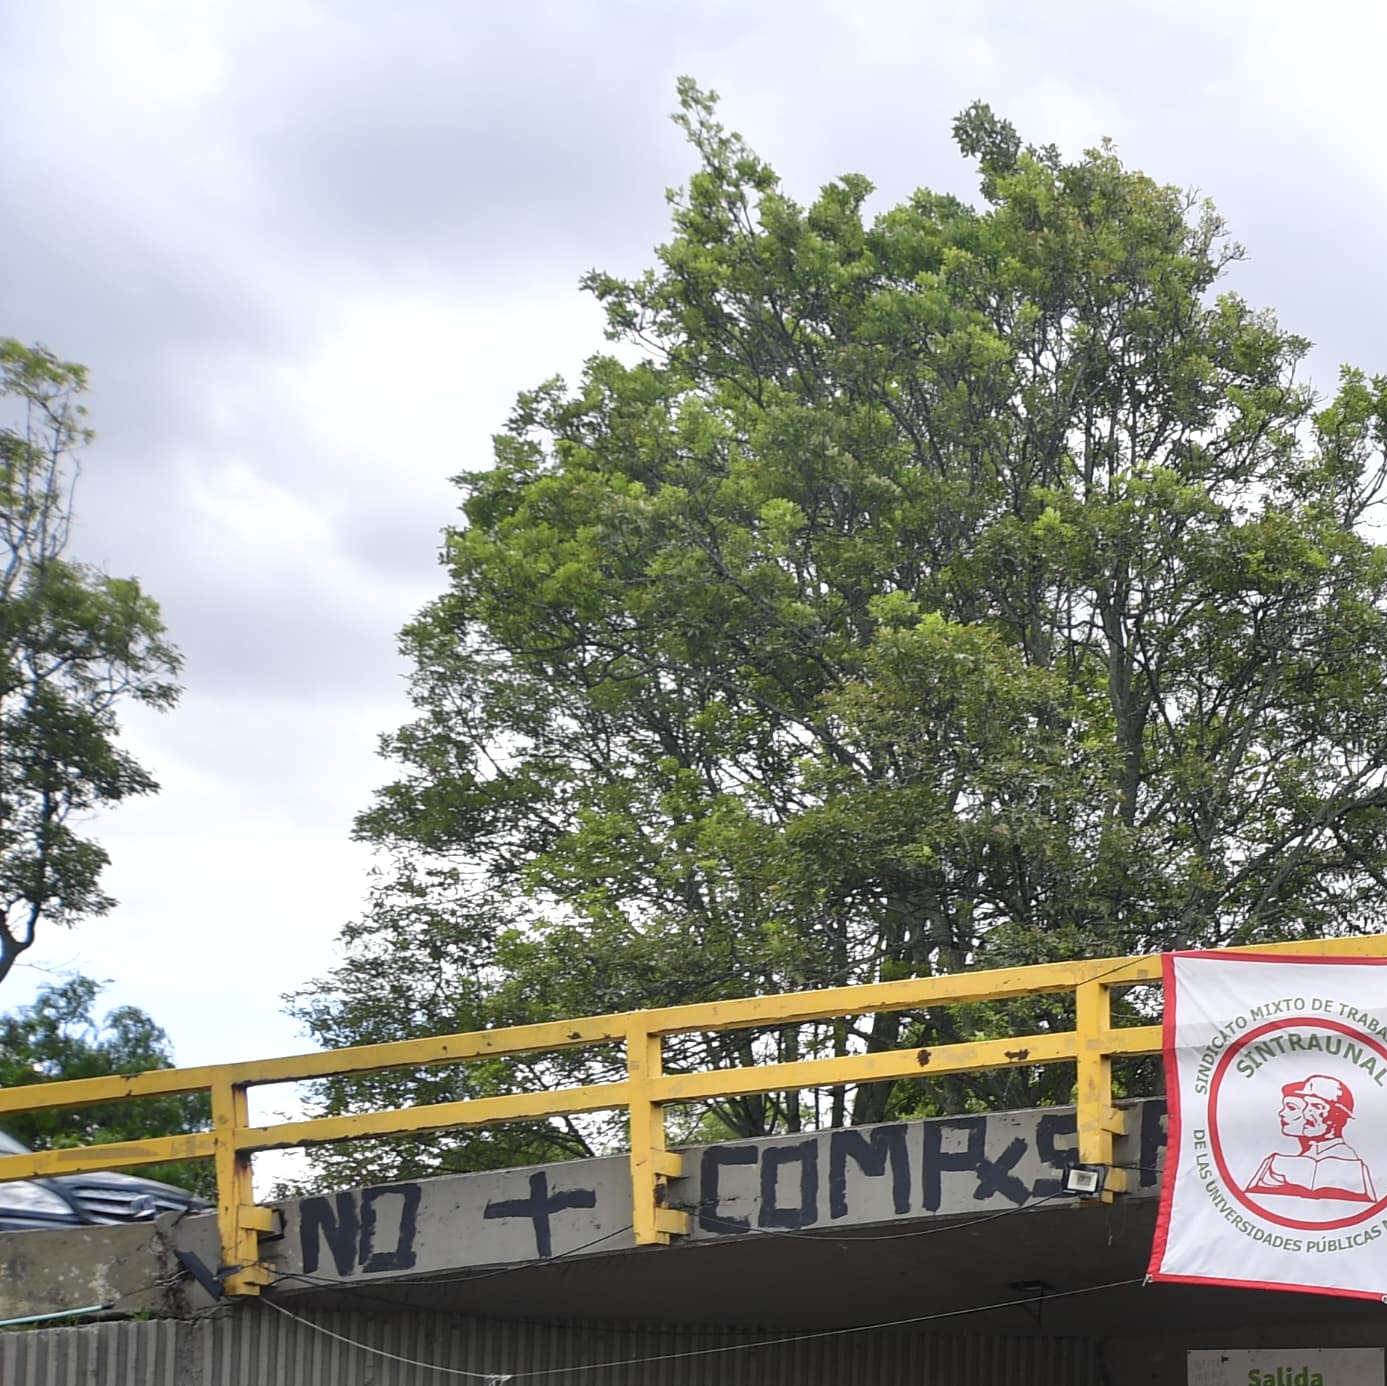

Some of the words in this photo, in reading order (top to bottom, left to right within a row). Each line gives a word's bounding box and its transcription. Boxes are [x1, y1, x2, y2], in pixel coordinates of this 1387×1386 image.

[1194, 1017, 1247, 1095] SINDICATO
[1251, 998, 1305, 1022] MIXTO
[1312, 999, 1332, 1013] DE
[1236, 1034, 1387, 1086] SINTRAUNAL
[1193, 1129, 1206, 1151] DE
[1195, 1152, 1212, 1181] LAS
[299, 1182, 418, 1277] NO
[1206, 1180, 1301, 1252] UNIVERSIDADES
[1307, 1227, 1381, 1253] PÚBLICAS
